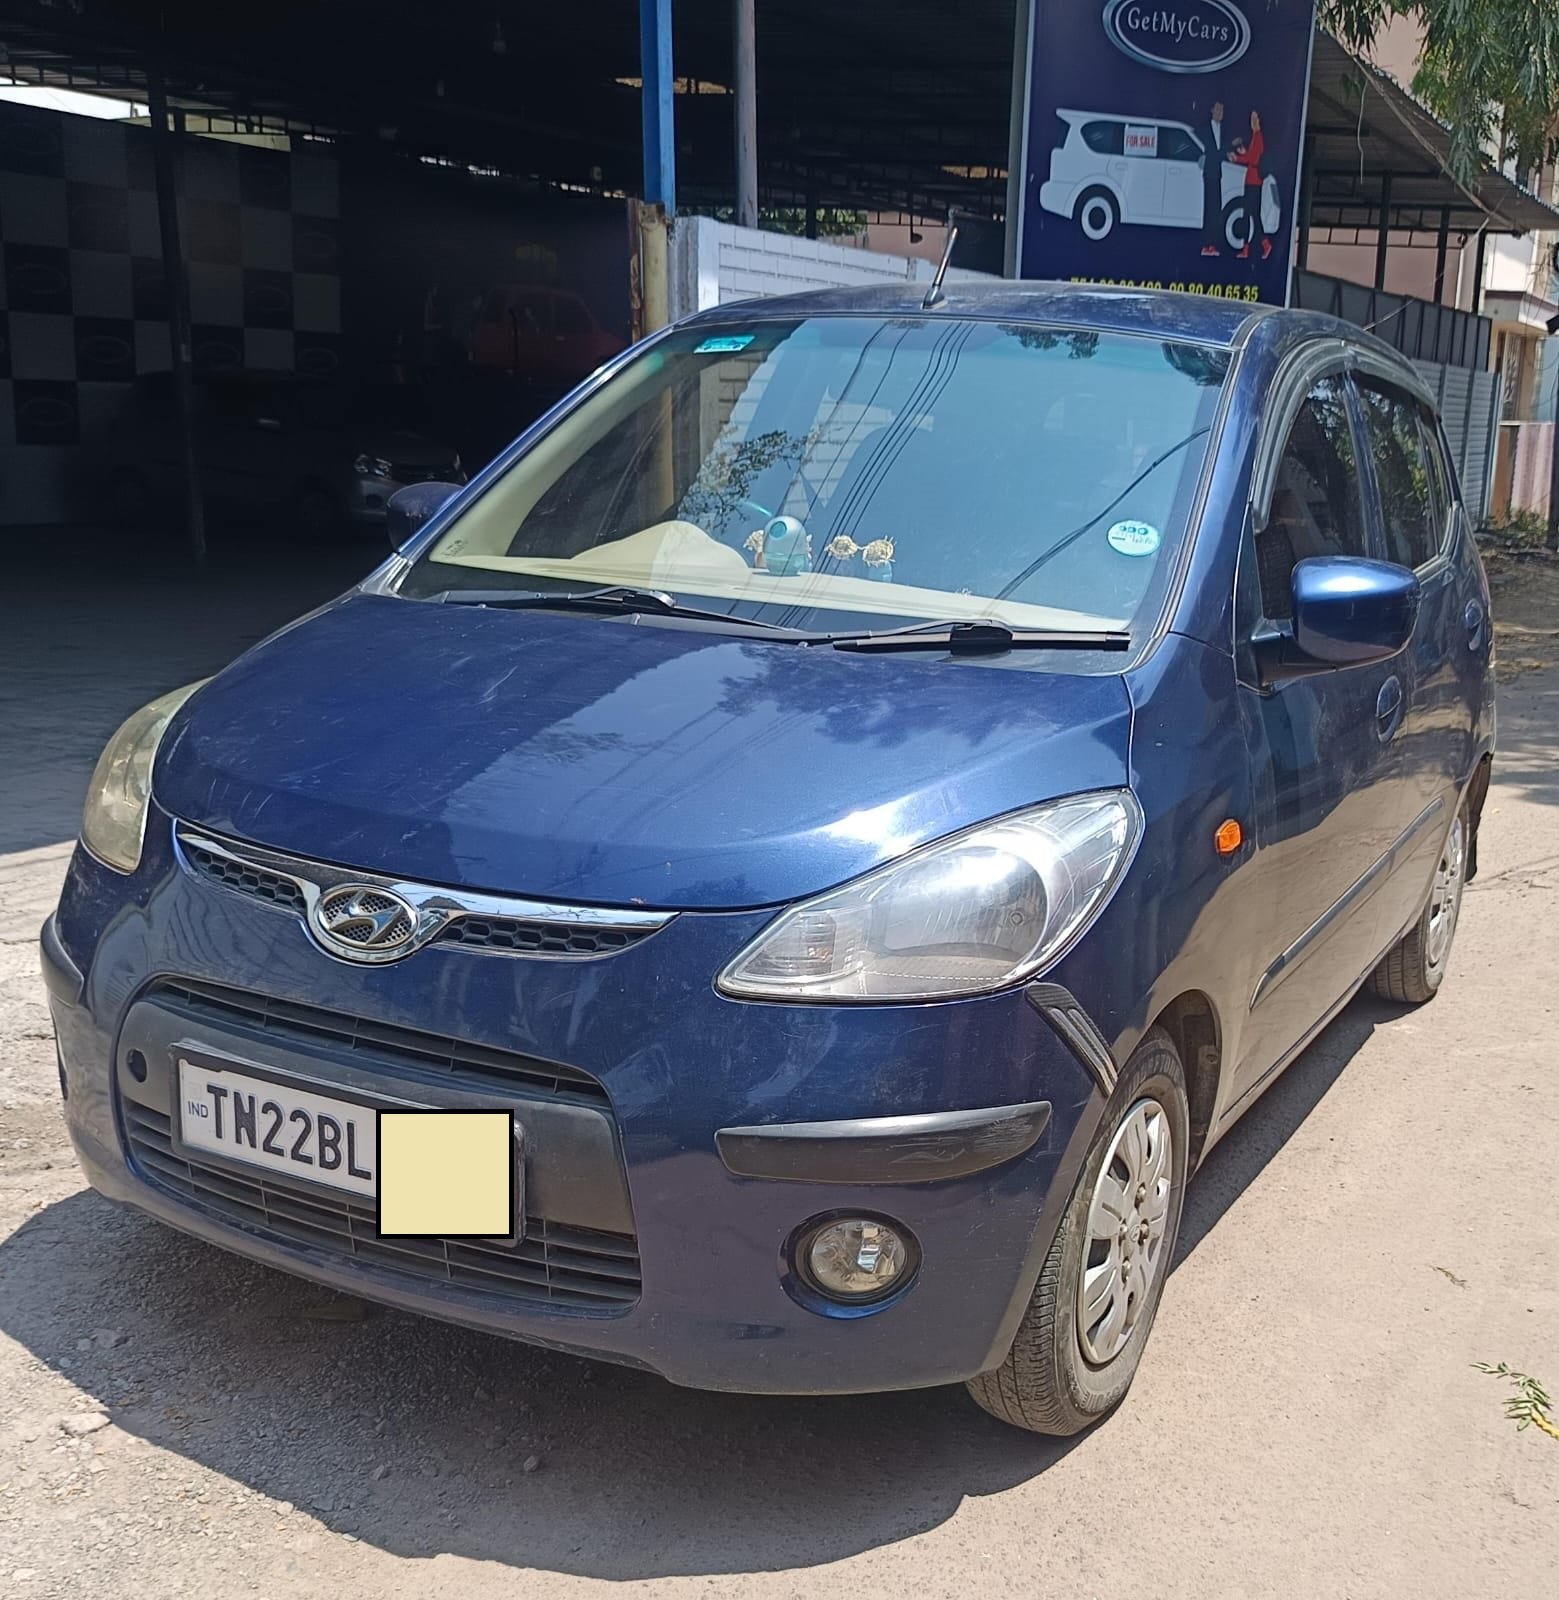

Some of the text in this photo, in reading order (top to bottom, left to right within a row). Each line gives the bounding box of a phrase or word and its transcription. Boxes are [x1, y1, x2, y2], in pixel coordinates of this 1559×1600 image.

[1127, 6, 1229, 43] GetMyCars
[1126, 135, 1156, 148] FOR SALE
[1206, 284, 1222, 297] 40
[1225, 284, 1241, 300] 65
[1243, 285, 1259, 302] 35
[188, 1101, 208, 1118] IND
[207, 1084, 372, 1181] TN22BL
